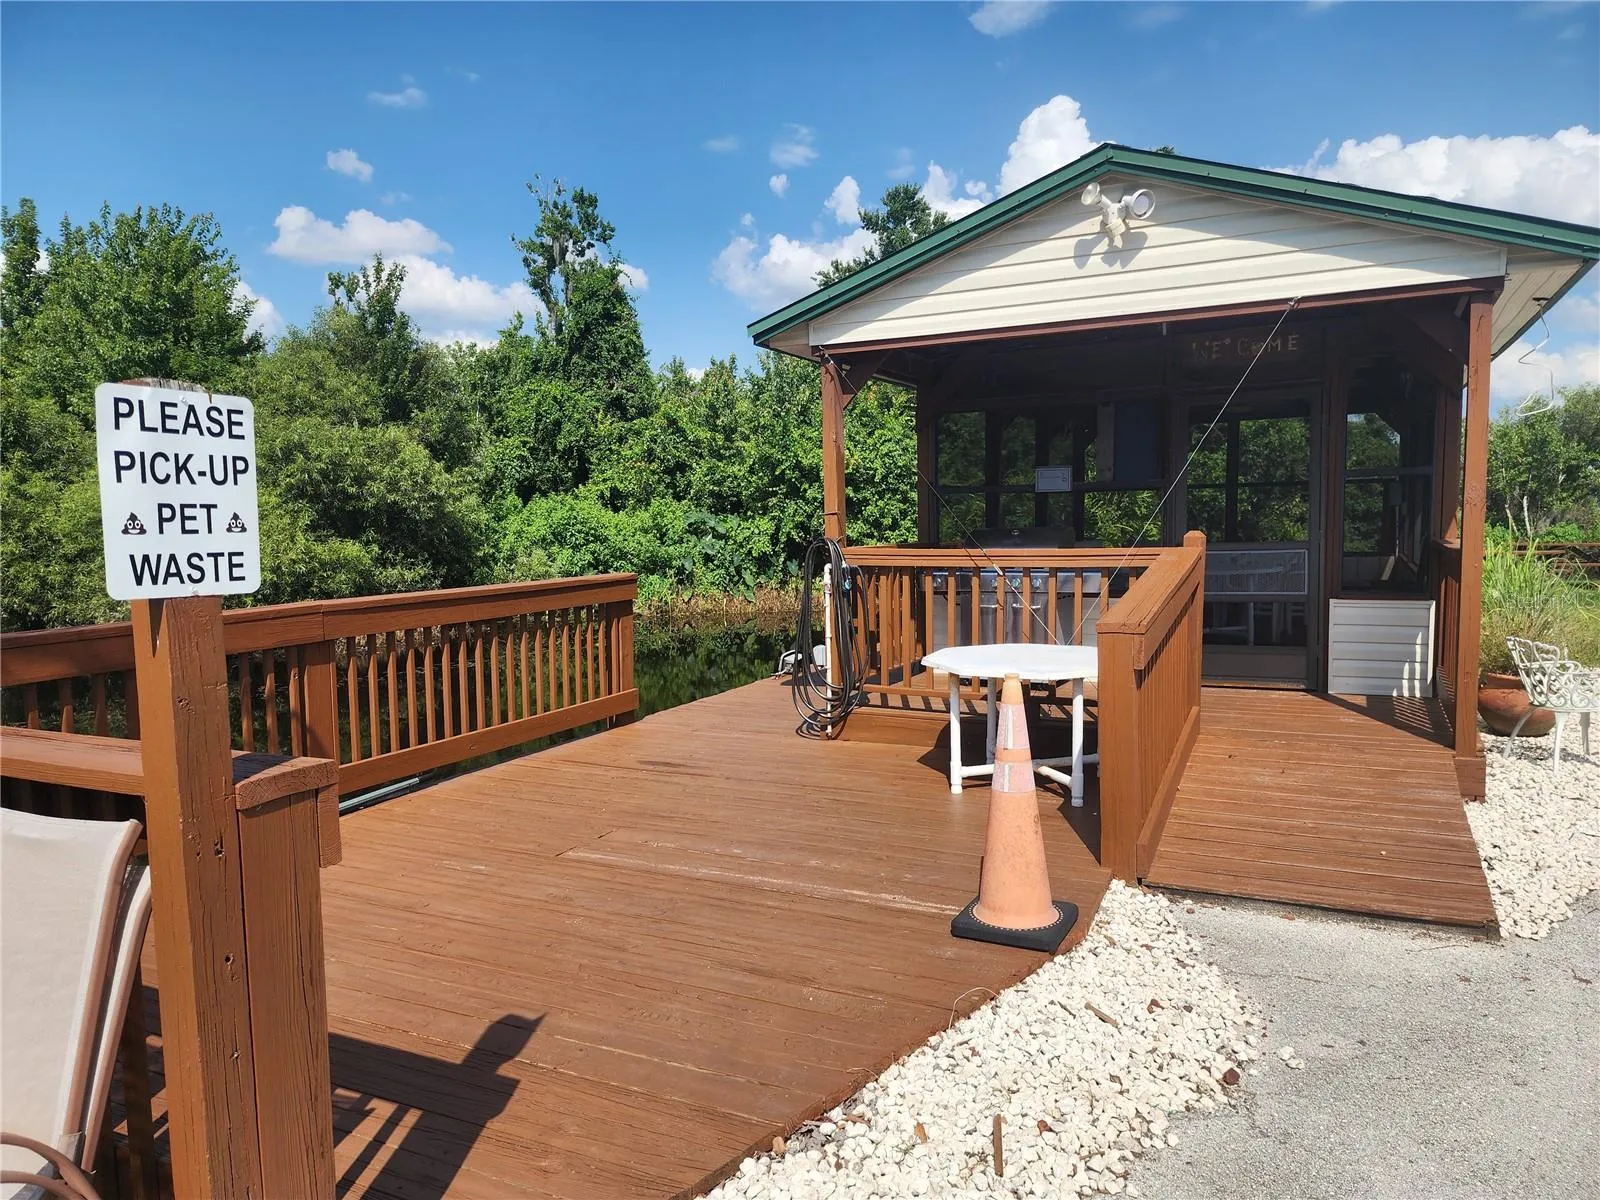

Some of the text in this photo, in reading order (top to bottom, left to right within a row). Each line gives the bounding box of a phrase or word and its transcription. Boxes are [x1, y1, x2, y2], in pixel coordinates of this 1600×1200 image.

[113, 396, 246, 440] PLEASE
[113, 450, 250, 486] PICK-UP
[157, 502, 218, 535] PET
[129, 551, 246, 587] WASTE
